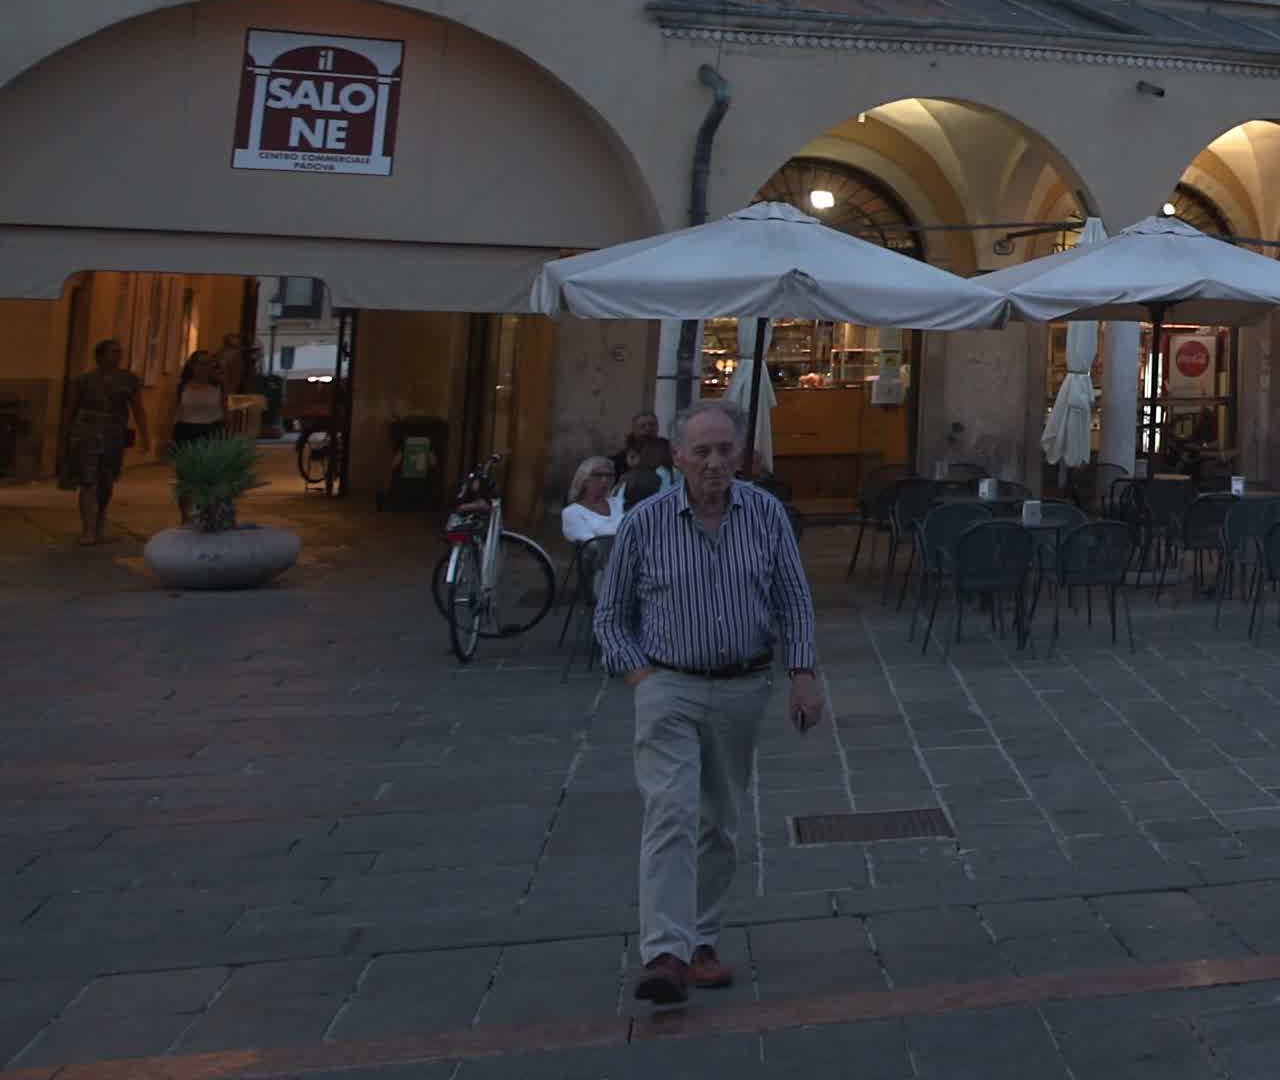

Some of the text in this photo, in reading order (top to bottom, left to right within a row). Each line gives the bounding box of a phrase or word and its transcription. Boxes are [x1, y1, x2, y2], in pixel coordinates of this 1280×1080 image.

[318, 49, 335, 72] il
[266, 77, 376, 114] SALO
[288, 116, 349, 150] NE
[258, 151, 371, 164] CENTRO COMMERCIALE
[293, 161, 336, 170] PADOVA
